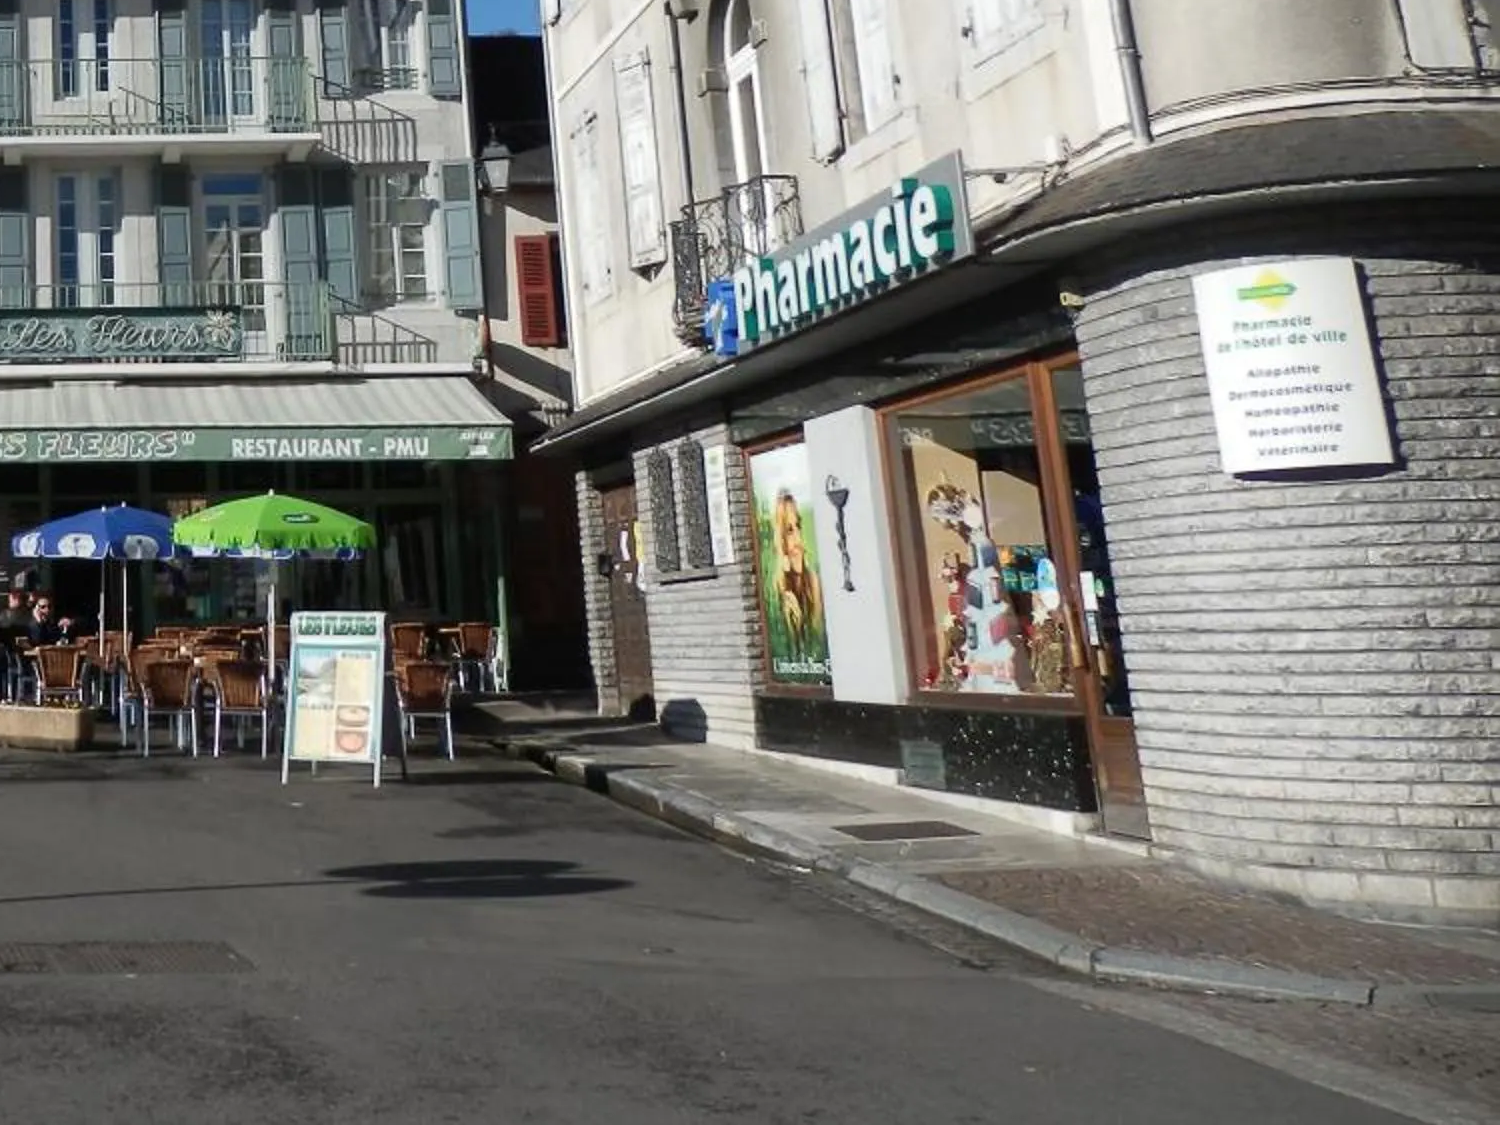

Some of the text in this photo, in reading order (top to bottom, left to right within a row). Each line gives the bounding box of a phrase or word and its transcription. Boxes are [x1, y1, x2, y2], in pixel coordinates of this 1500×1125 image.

[733, 181, 940, 341] Pharmacie
[0, 313, 201, 352] Les Fleurs
[1233, 314, 1312, 334] Pharmacie
[1287, 331, 1309, 345] de
[1313, 330, 1348, 344] ville
[231, 438, 363, 458] RESTAURANT
[383, 437, 430, 457] PMU
